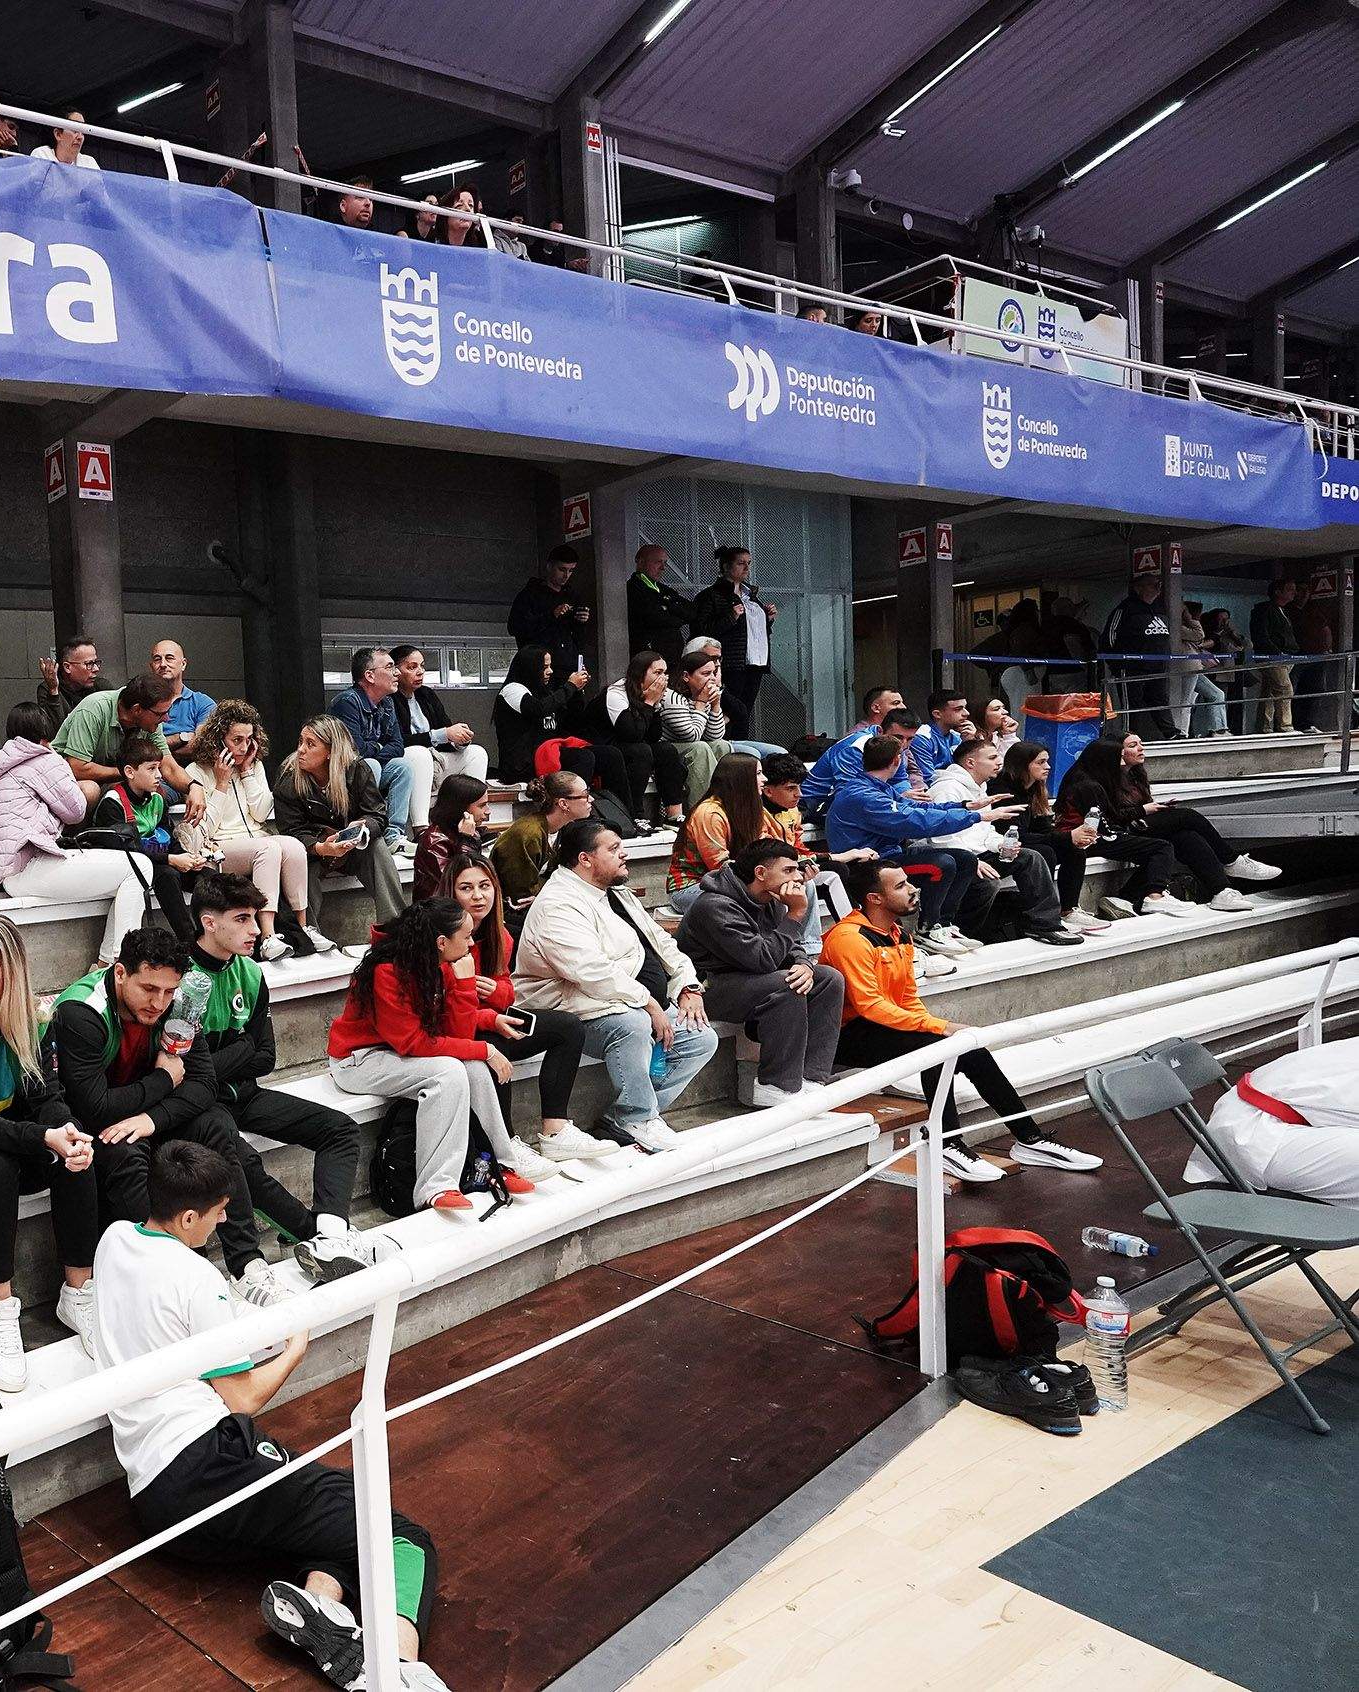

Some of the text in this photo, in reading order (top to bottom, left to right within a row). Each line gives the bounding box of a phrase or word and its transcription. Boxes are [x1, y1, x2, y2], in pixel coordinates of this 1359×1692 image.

[588, 132, 600, 143] AA
[453, 311, 533, 344] Concello
[1059, 326, 1085, 342] Concello
[455, 341, 583, 380] de Pontevedra
[786, 366, 875, 401] Deputación
[789, 392, 876, 426] Pontevedra
[1017, 414, 1059, 436] Concello
[1017, 436, 1088, 460] de Pontevedra
[1183, 442, 1214, 460] XUNTA
[49, 456, 63, 486] A
[83, 456, 107, 485] A
[1183, 461, 1231, 481] DE GALICIA
[1321, 481, 1359, 501] DEPO
[568, 505, 586, 529] A
[902, 537, 922, 557] A
[939, 532, 950, 550] A
[1138, 553, 1156, 570] A
[1172, 550, 1180, 565] A
